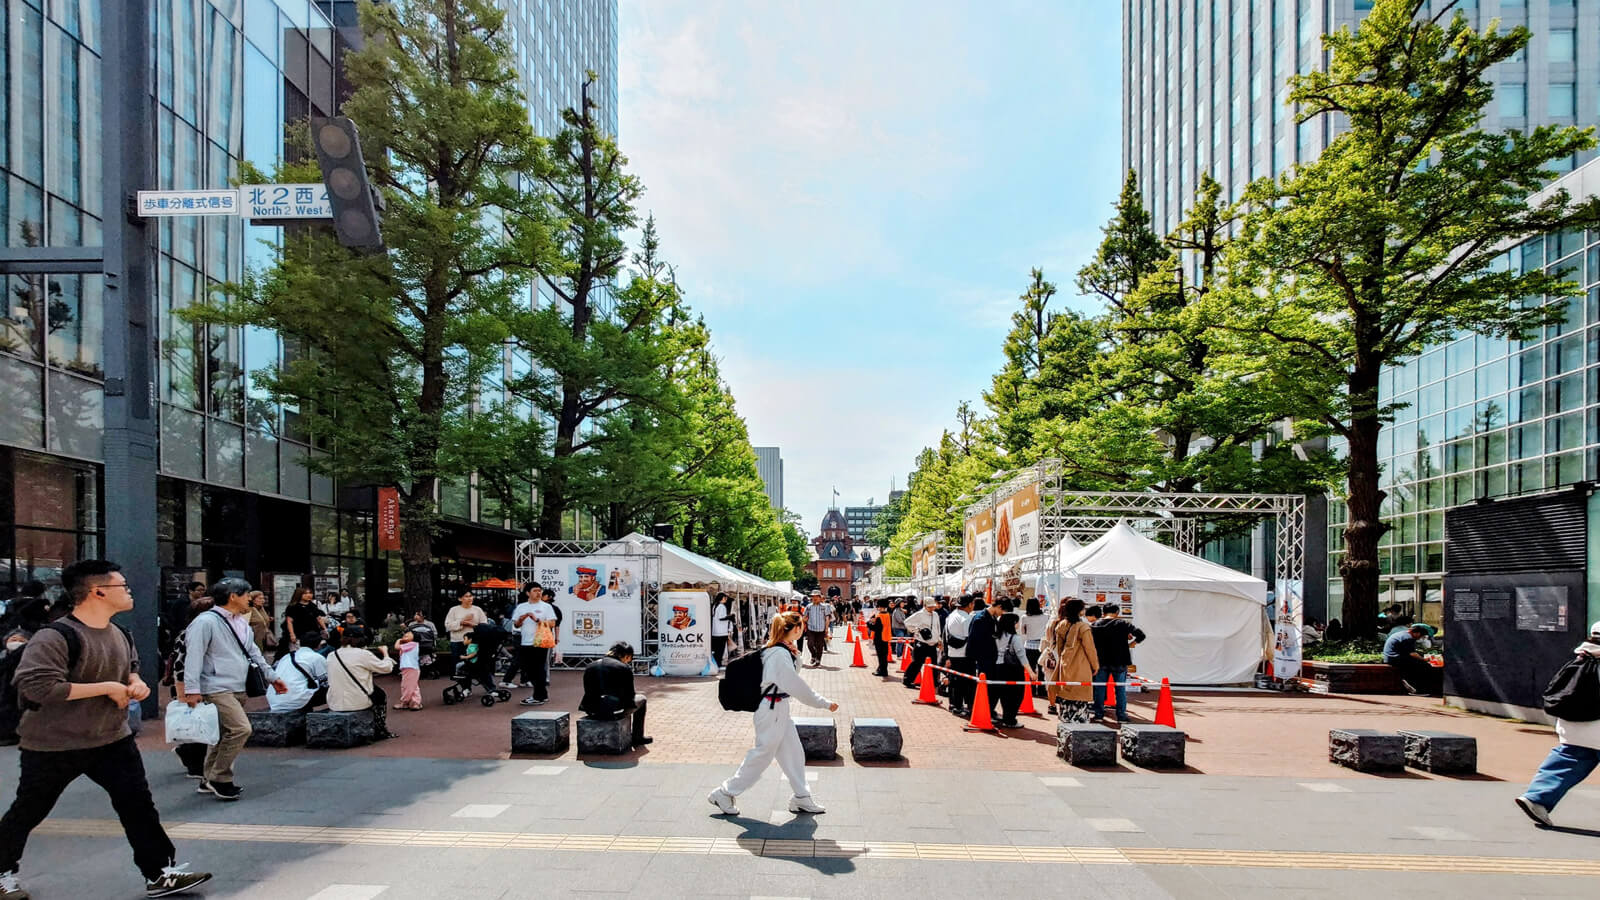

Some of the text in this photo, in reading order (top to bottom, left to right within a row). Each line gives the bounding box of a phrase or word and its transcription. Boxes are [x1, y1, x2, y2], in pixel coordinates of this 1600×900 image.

[144, 196, 233, 209] 歩車分離式信号
[253, 206, 282, 216] North
[284, 206, 292, 216] 2
[296, 206, 323, 215] West
[387, 498, 395, 540] Akarenga
[583, 618, 593, 629] B
[660, 633, 705, 643] BLACK
